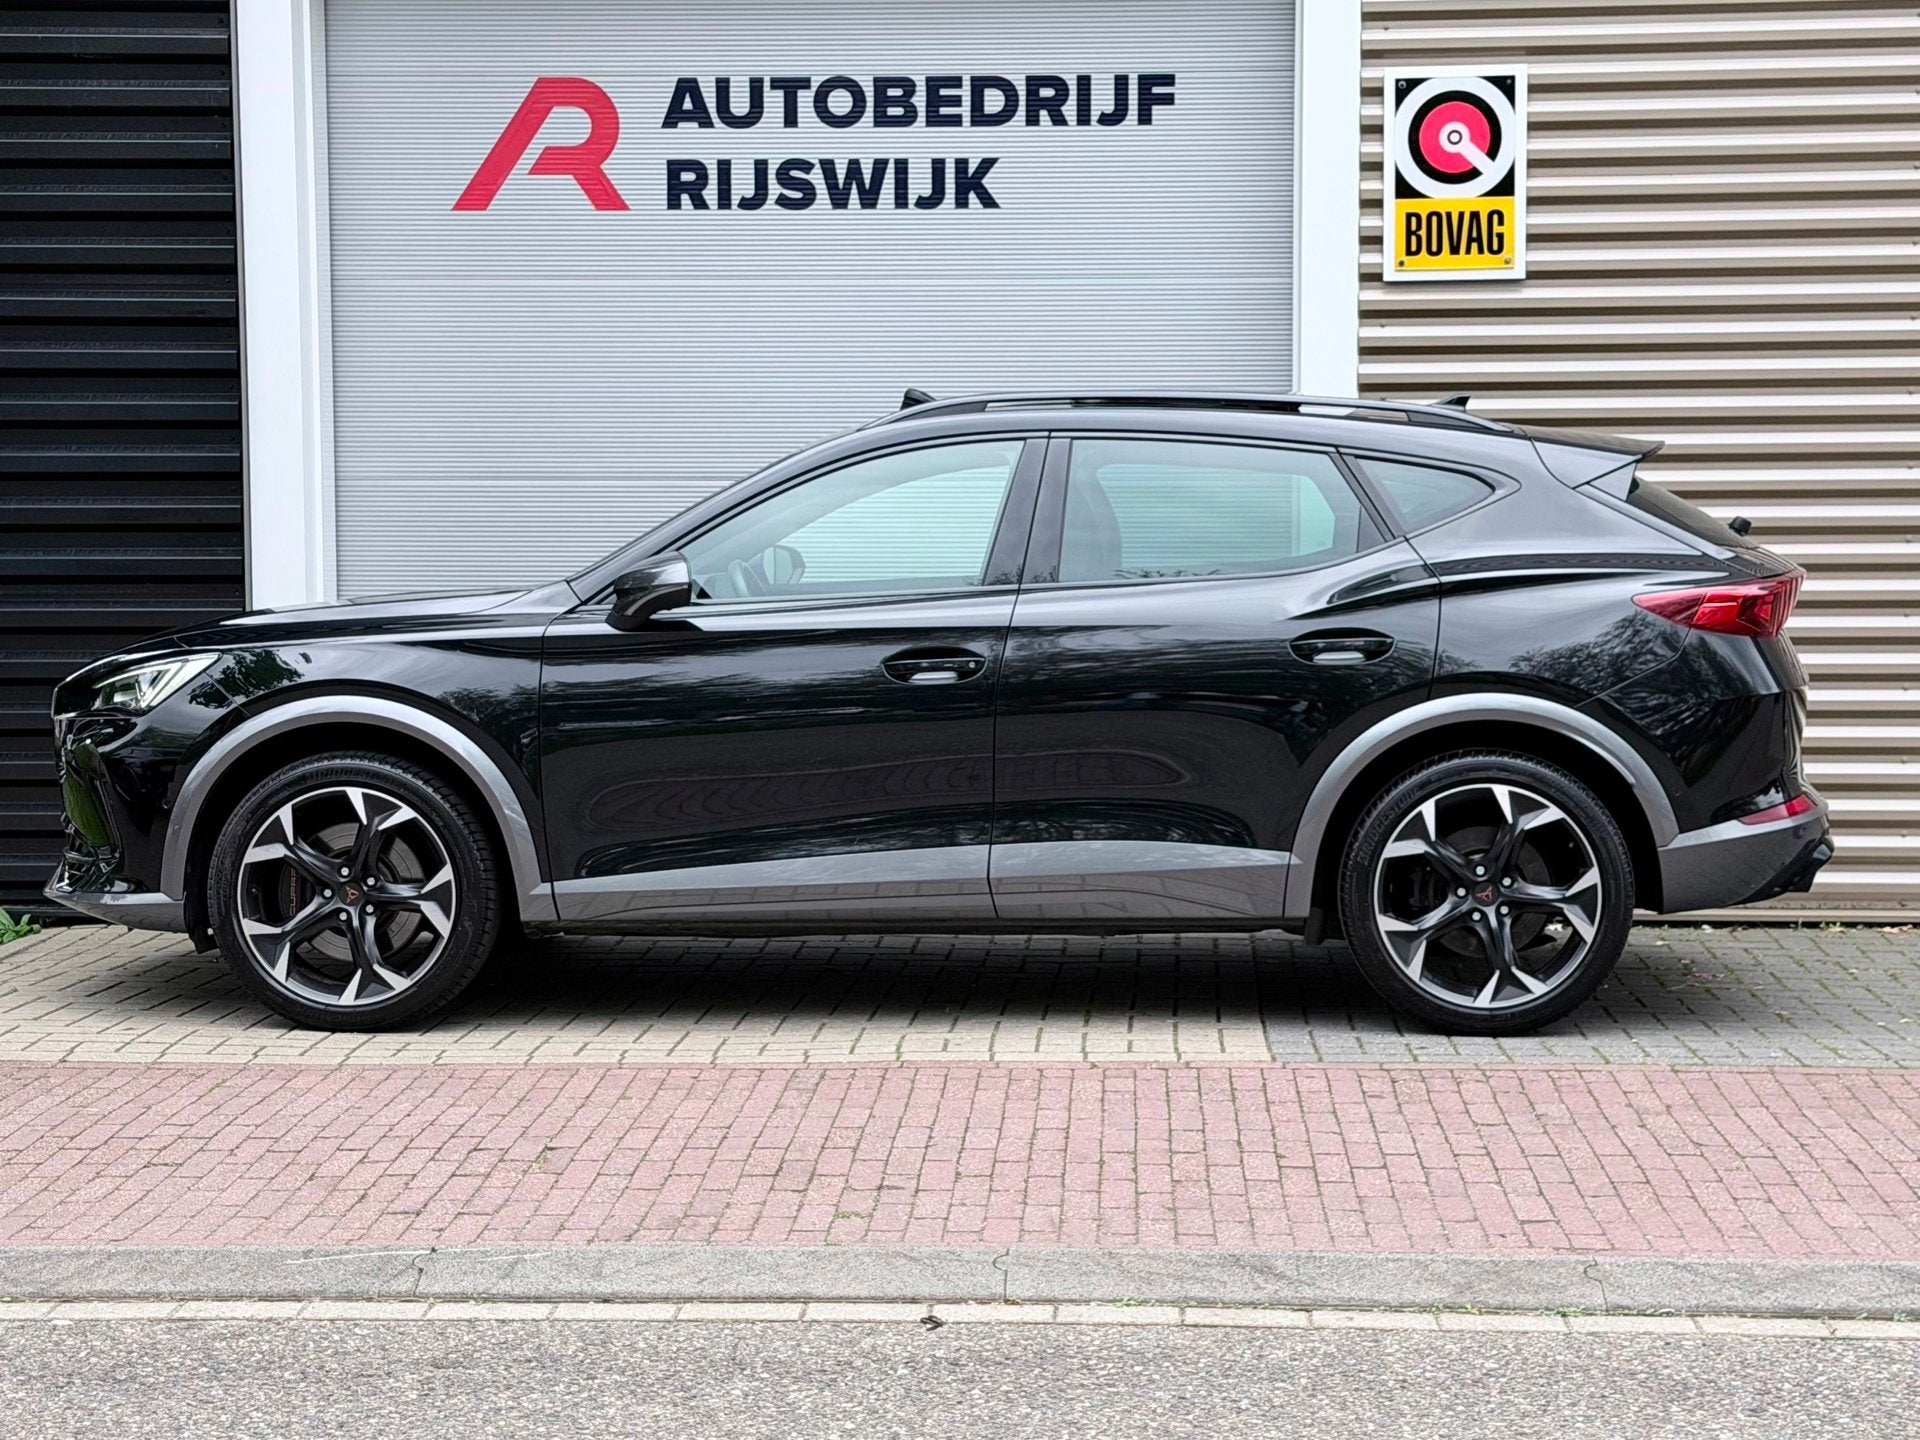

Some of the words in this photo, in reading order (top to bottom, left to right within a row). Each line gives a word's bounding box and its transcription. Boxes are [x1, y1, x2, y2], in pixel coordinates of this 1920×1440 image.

[660, 73, 1176, 129] AUTOBEDRIJF
[666, 157, 1001, 211] RIJSWIJK
[1405, 209, 1505, 257] BOVAG
